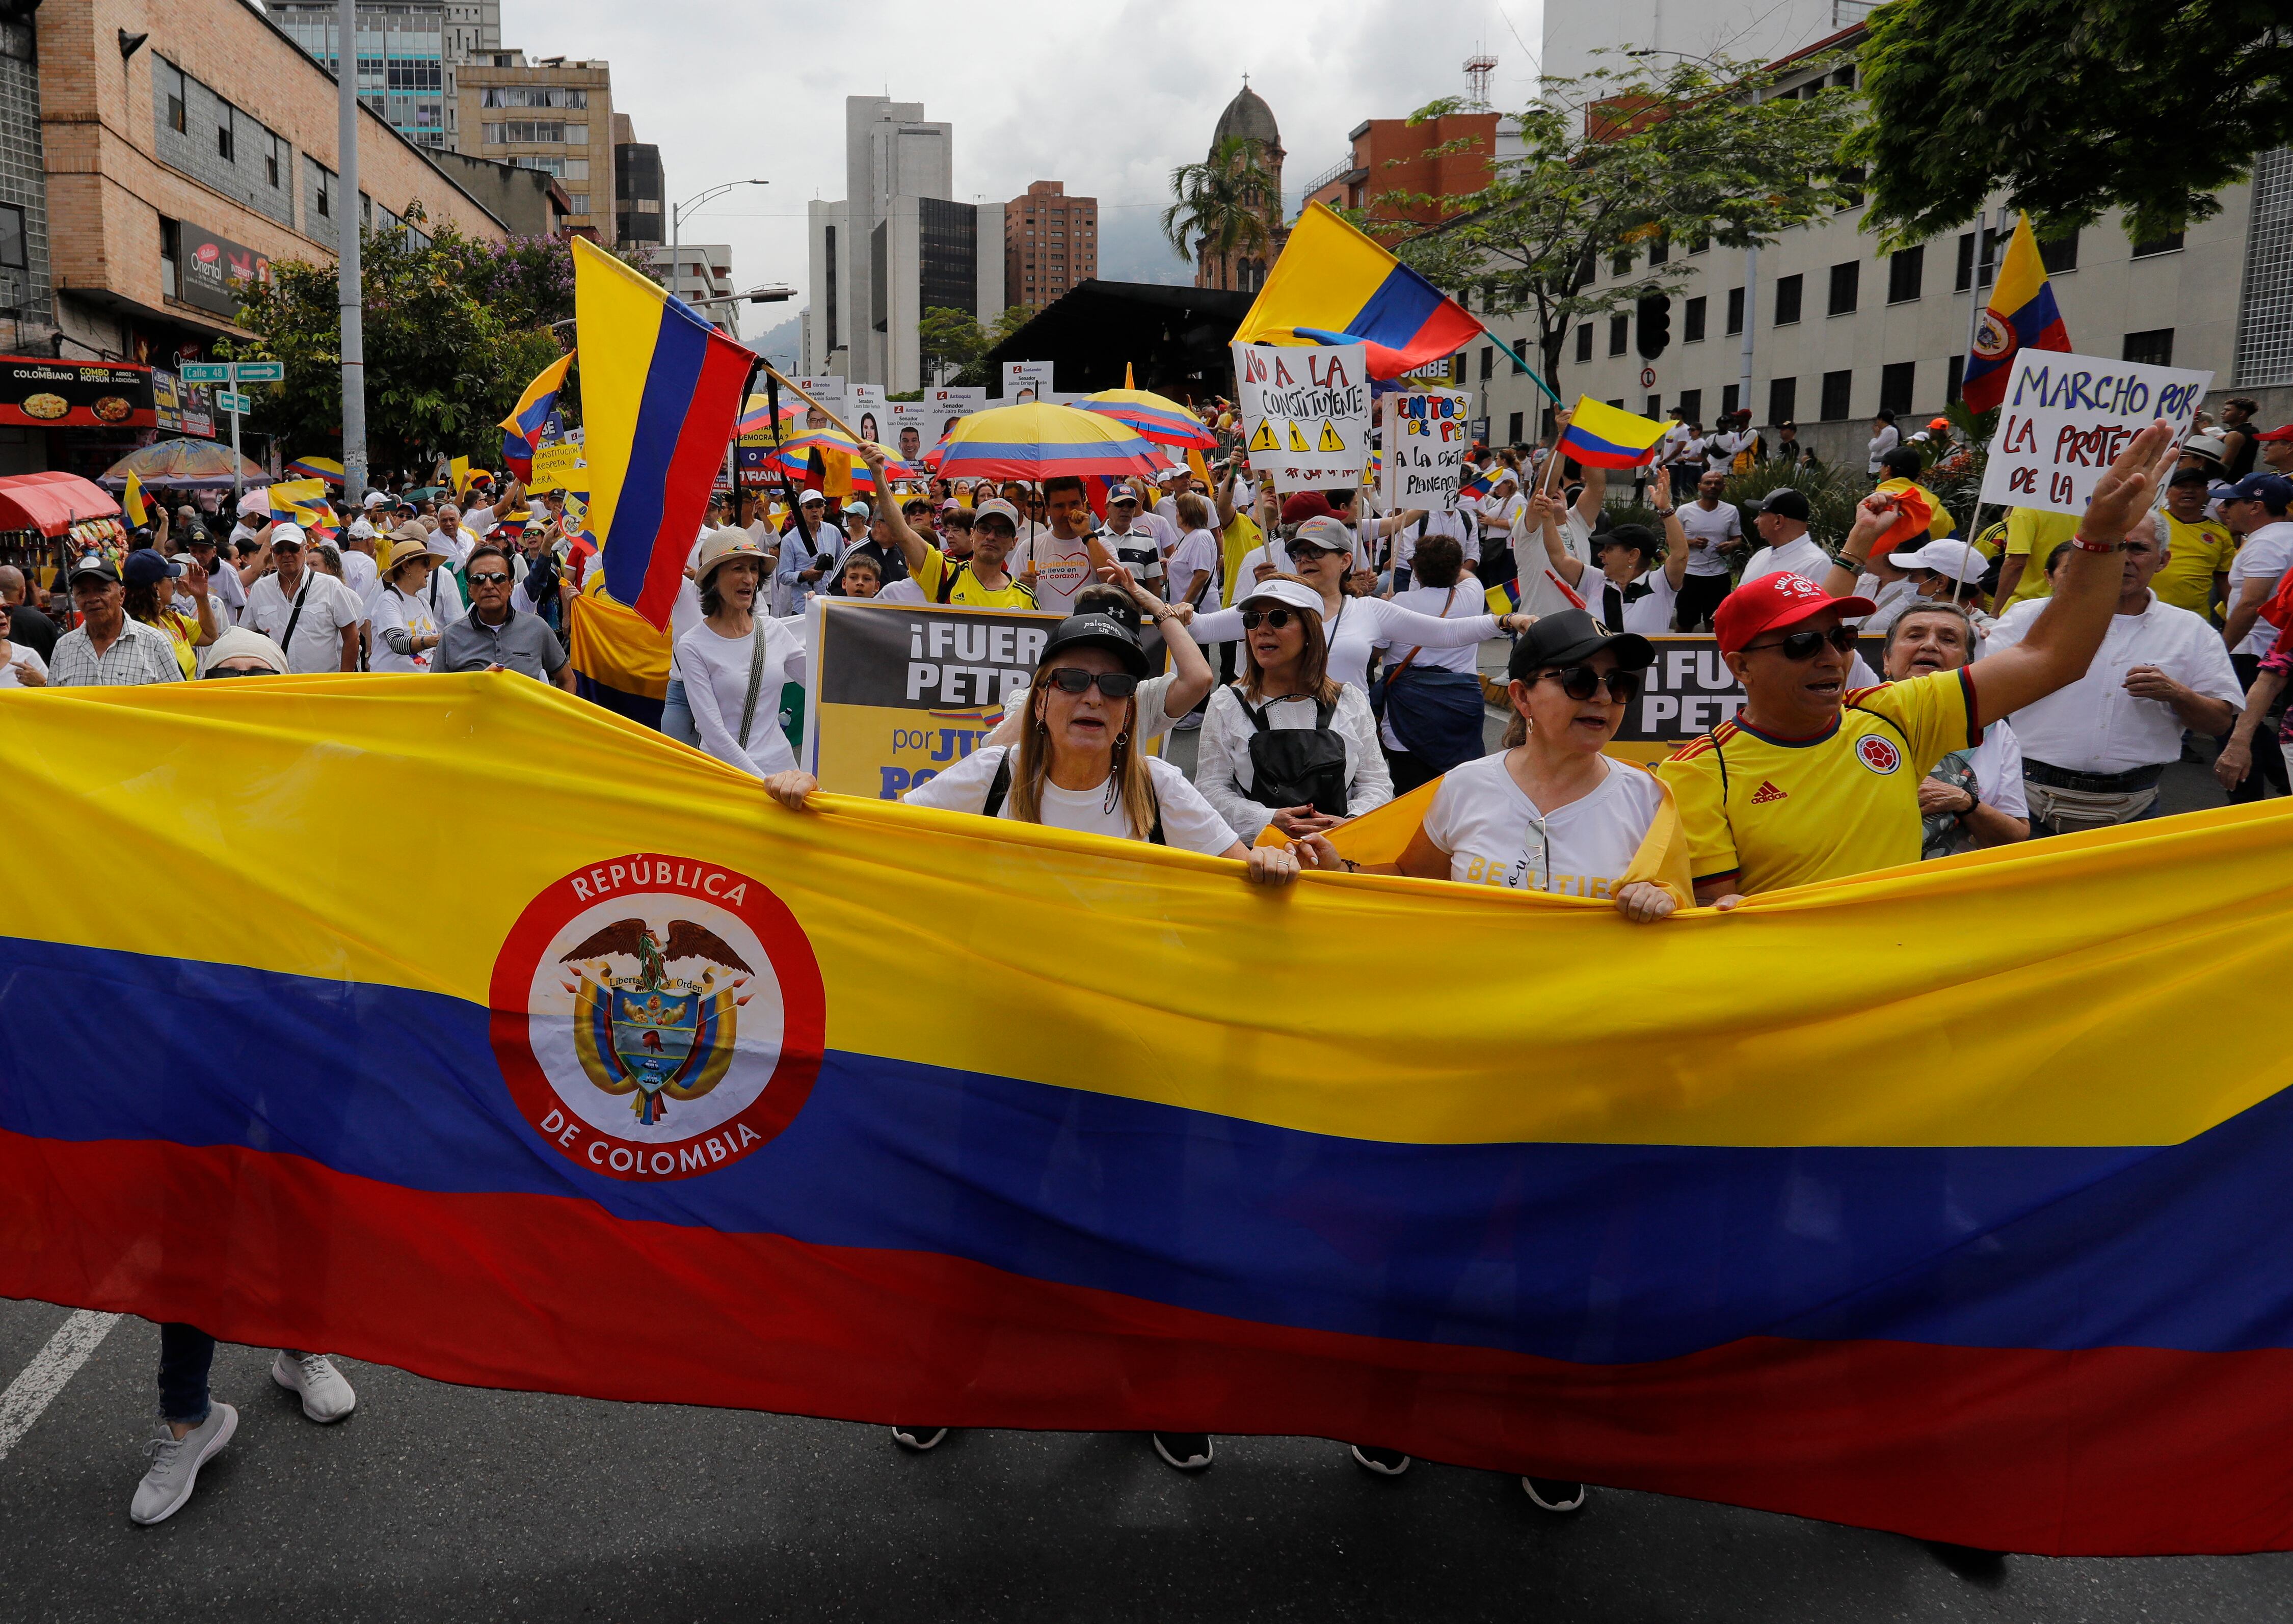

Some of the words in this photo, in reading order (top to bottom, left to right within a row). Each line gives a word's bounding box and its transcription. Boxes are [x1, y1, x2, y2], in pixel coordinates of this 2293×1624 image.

[13, 370, 74, 381] COLOMBIANO
[79, 367, 109, 376] COMBO
[81, 374, 110, 383] HOTSUN
[187, 368, 207, 377] Calle
[213, 368, 223, 377] 48
[1245, 349, 1267, 384] NO
[1275, 356, 1295, 389] A
[1309, 355, 1349, 388] LA
[2013, 365, 2149, 416] MARCHO
[2153, 383, 2198, 421] POR
[1408, 419, 1431, 437] DE
[1440, 421, 1469, 442] PET
[2003, 415, 2037, 454] LA
[1396, 451, 1407, 467] A
[1414, 446, 1432, 468] LA
[1438, 449, 1464, 468] DICTA
[740, 470, 790, 481] TIRAN
[1407, 474, 1459, 495] PLANEADA
[2009, 467, 2038, 494] DE
[2050, 472, 2072, 504] LA
[1039, 560, 1087, 569] Colombia,
[1084, 619, 1122, 636] palosanto
[911, 622, 1048, 665] ¡FUER
[906, 662, 1031, 705] PETR
[1645, 651, 1747, 692] ¡FU
[1642, 695, 1748, 733] PET
[893, 729, 934, 754] por
[931, 728, 990, 762] JU
[879, 766, 938, 799] PO
[1751, 792, 1788, 804] adidas
[571, 854, 747, 907] REPÚBLICA
[609, 977, 644, 987] Libertad
[666, 981, 671, 989] y
[677, 979, 703, 992] Orden
[540, 1108, 581, 1148] DE
[588, 1123, 761, 1174] COLOMBIA
